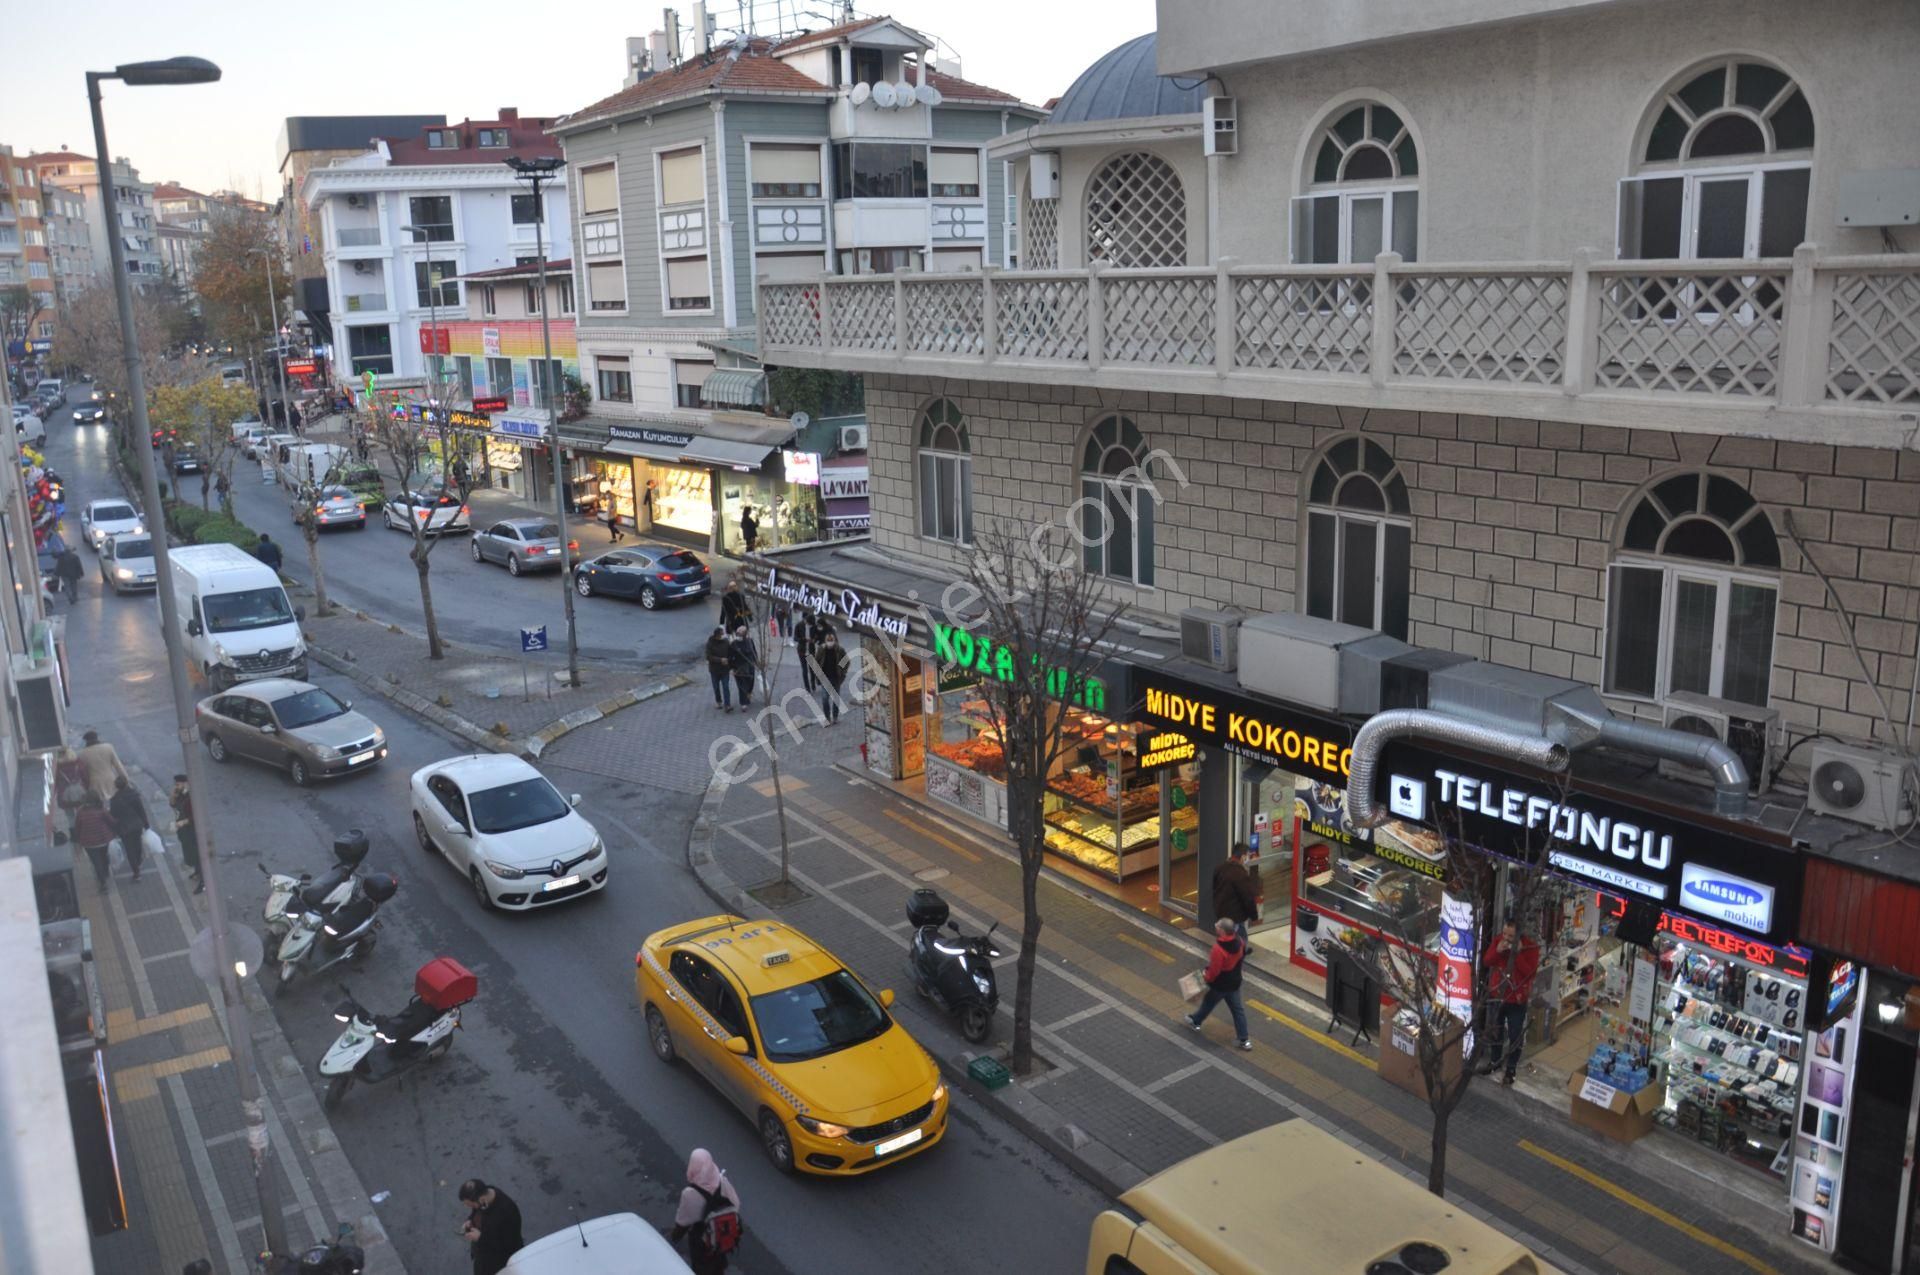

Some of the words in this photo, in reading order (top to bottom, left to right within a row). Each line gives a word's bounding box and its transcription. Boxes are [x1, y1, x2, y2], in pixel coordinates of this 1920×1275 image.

[610, 427, 641, 439] RAMAZAN
[643, 430, 689, 444] KUYUMCULUK
[934, 622, 1014, 683] KOZA
[1150, 733, 1188, 751] MİDYE
[1223, 742, 1234, 752] ALİ
[1261, 754, 1279, 766] USTA
[1141, 743, 1195, 768] KOKOREÇ
[1434, 768, 1673, 870] TELEFONCU
[1375, 845, 1444, 880] KOKOREÇ
[1591, 868, 1655, 894] MARKET
[1694, 879, 1754, 906] SAMSUNG
[1723, 909, 1765, 930] mobile
[1697, 925, 1775, 966] TELEFON
